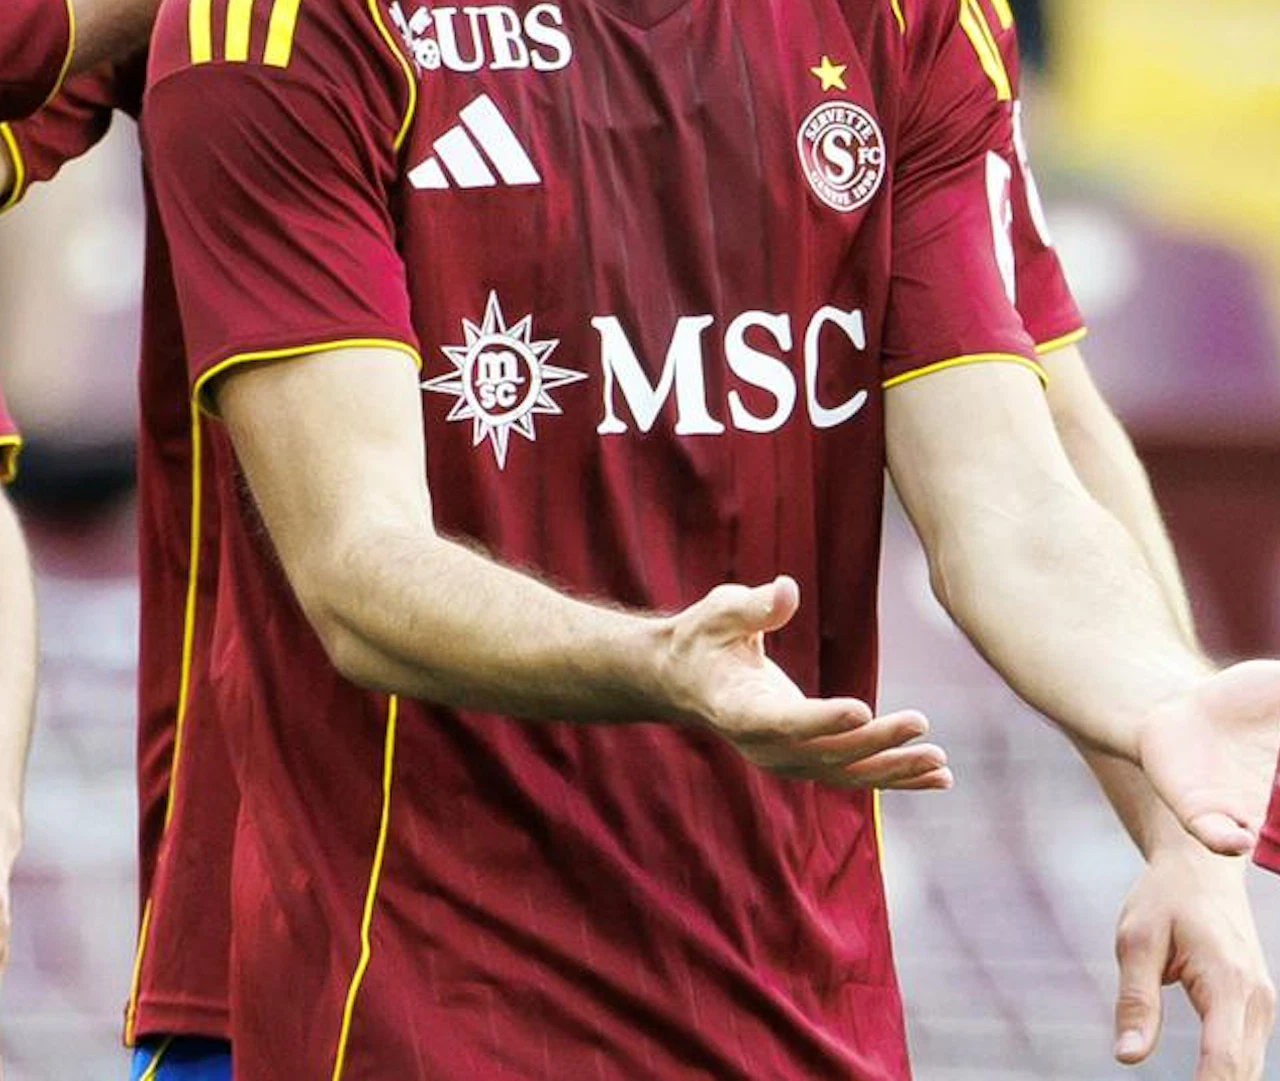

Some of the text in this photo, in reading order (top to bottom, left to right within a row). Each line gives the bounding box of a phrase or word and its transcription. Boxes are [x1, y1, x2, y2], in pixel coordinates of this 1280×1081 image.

[431, 3, 573, 72] UBS
[805, 108, 873, 142] SERVETTE
[822, 129, 855, 184] S
[857, 146, 881, 165] FC
[591, 305, 869, 435] MSC
